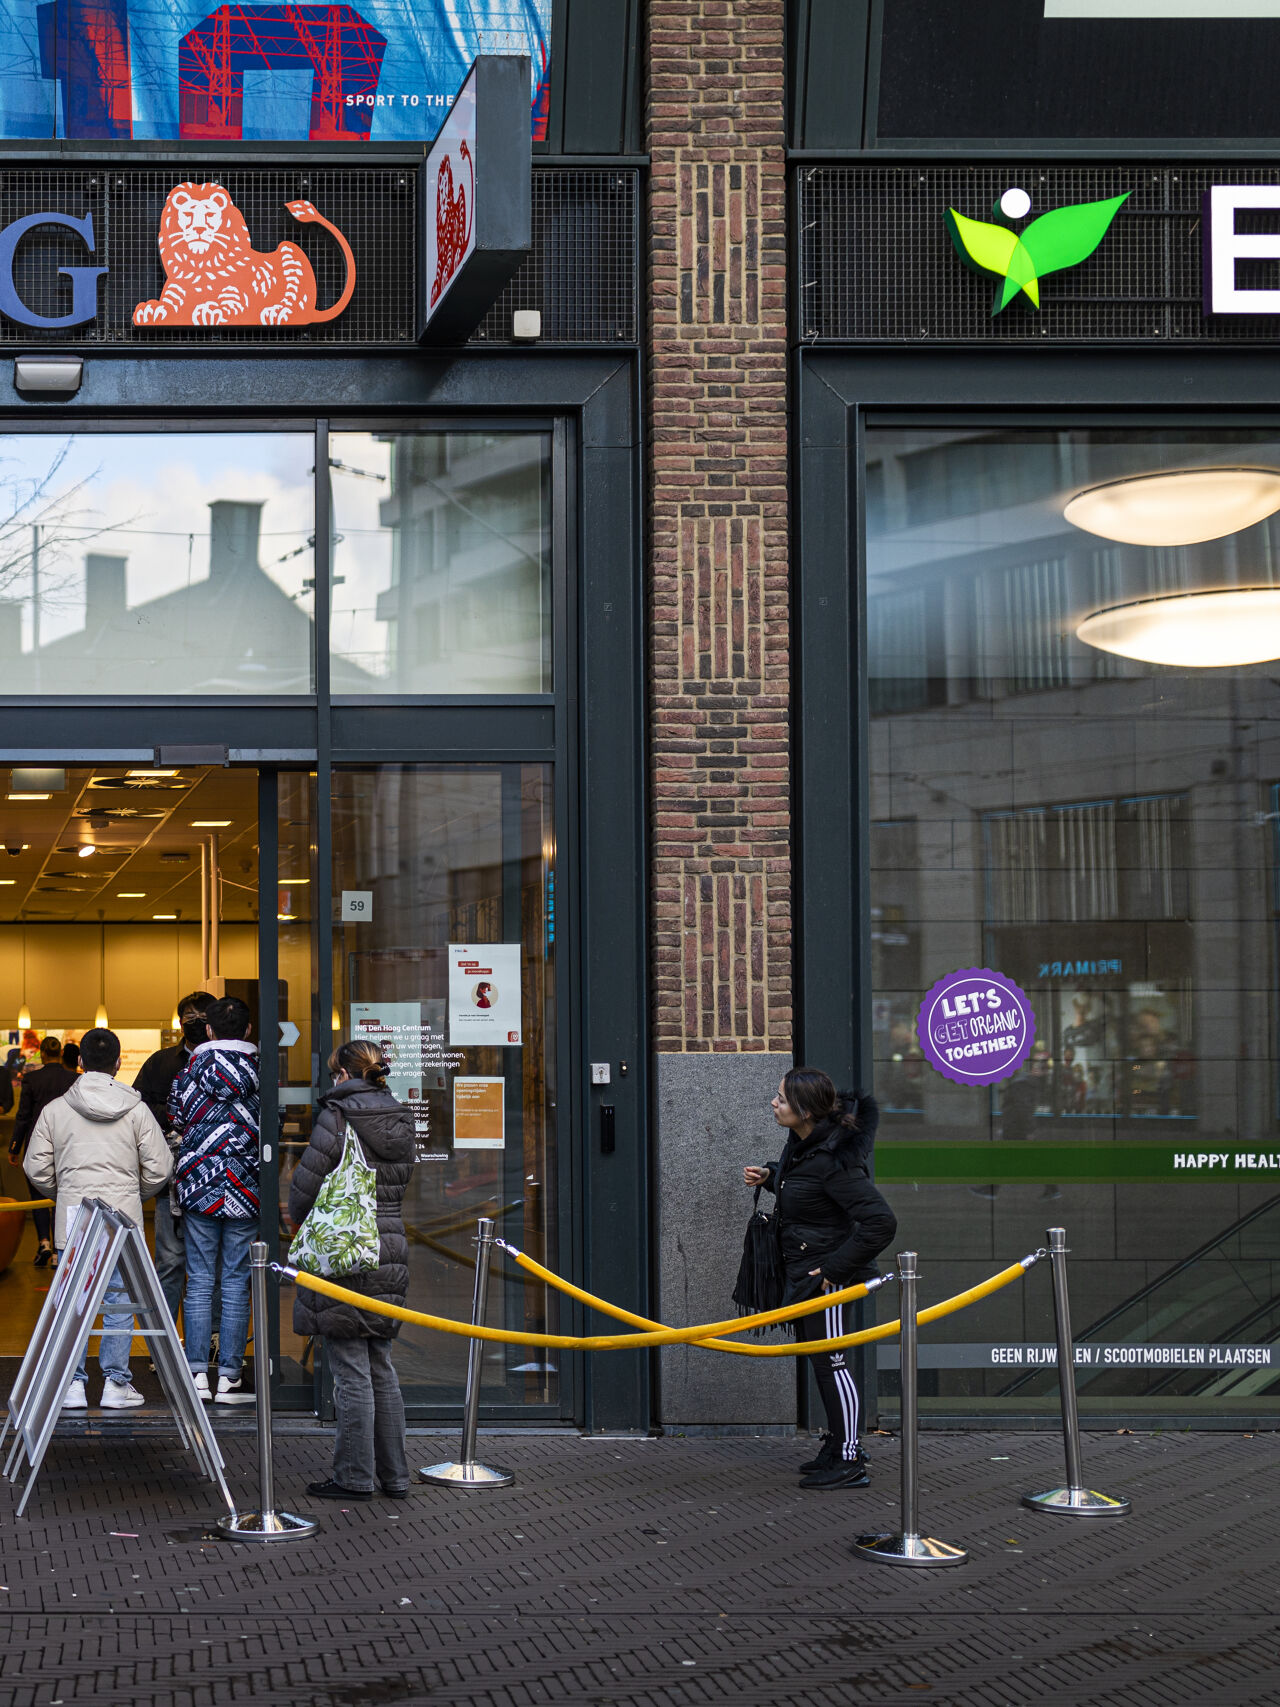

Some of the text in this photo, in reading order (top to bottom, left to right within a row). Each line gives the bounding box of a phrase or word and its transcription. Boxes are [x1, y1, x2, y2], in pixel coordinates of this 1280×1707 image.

[346, 94, 454, 106] SPORT TO THE
[350, 900, 365, 912] 59
[941, 988, 1002, 1019] LET'S
[935, 1008, 1021, 1045] GET ORGANIC
[369, 1034, 392, 1042] helpen
[407, 1043, 443, 1051] vermogen,
[945, 1035, 1018, 1062] TOGETHER
[414, 1061, 460, 1069] verzekeringen
[1173, 1153, 1229, 1169] HAPPY
[991, 1348, 1022, 1364] GEEN
[1026, 1348, 1092, 1364] RIJWEN
[1104, 1348, 1205, 1364] SCOOTMOBIELEN
[1208, 1348, 1271, 1365] PLAATSEN
